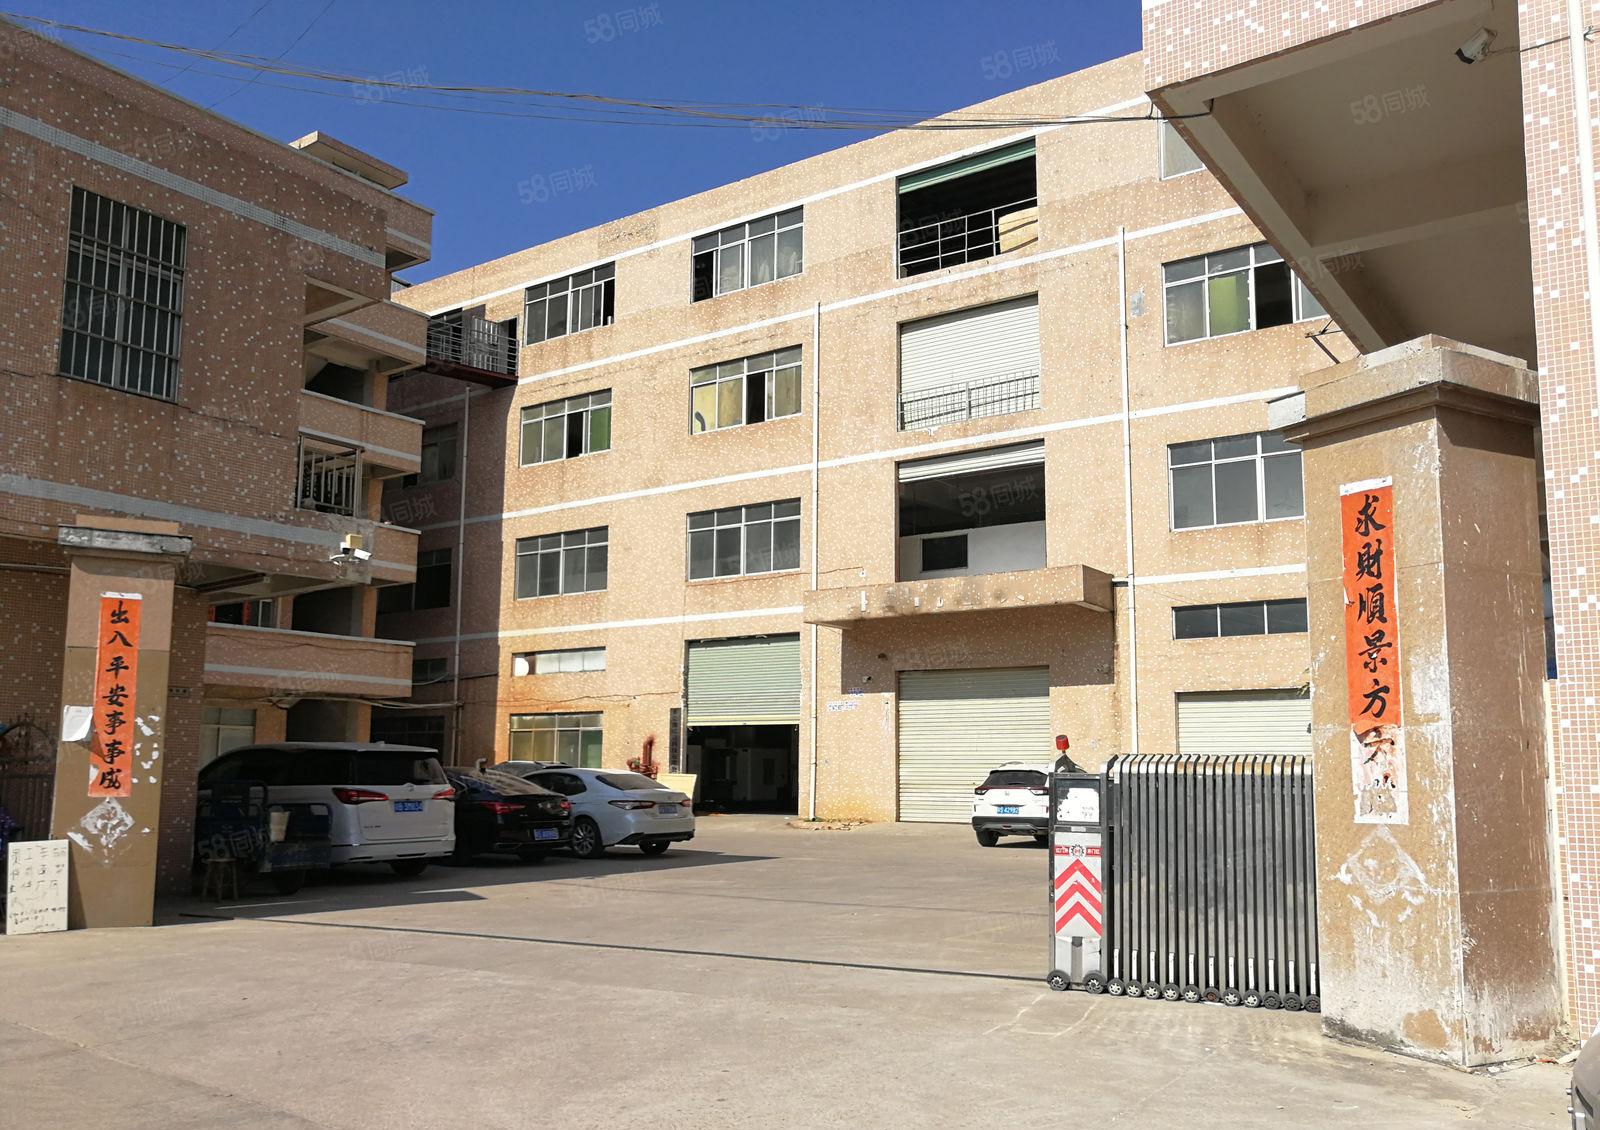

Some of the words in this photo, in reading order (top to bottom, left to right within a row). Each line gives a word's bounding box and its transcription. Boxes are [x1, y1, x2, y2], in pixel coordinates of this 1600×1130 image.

[98, 600, 134, 790] 出入平安事事成
